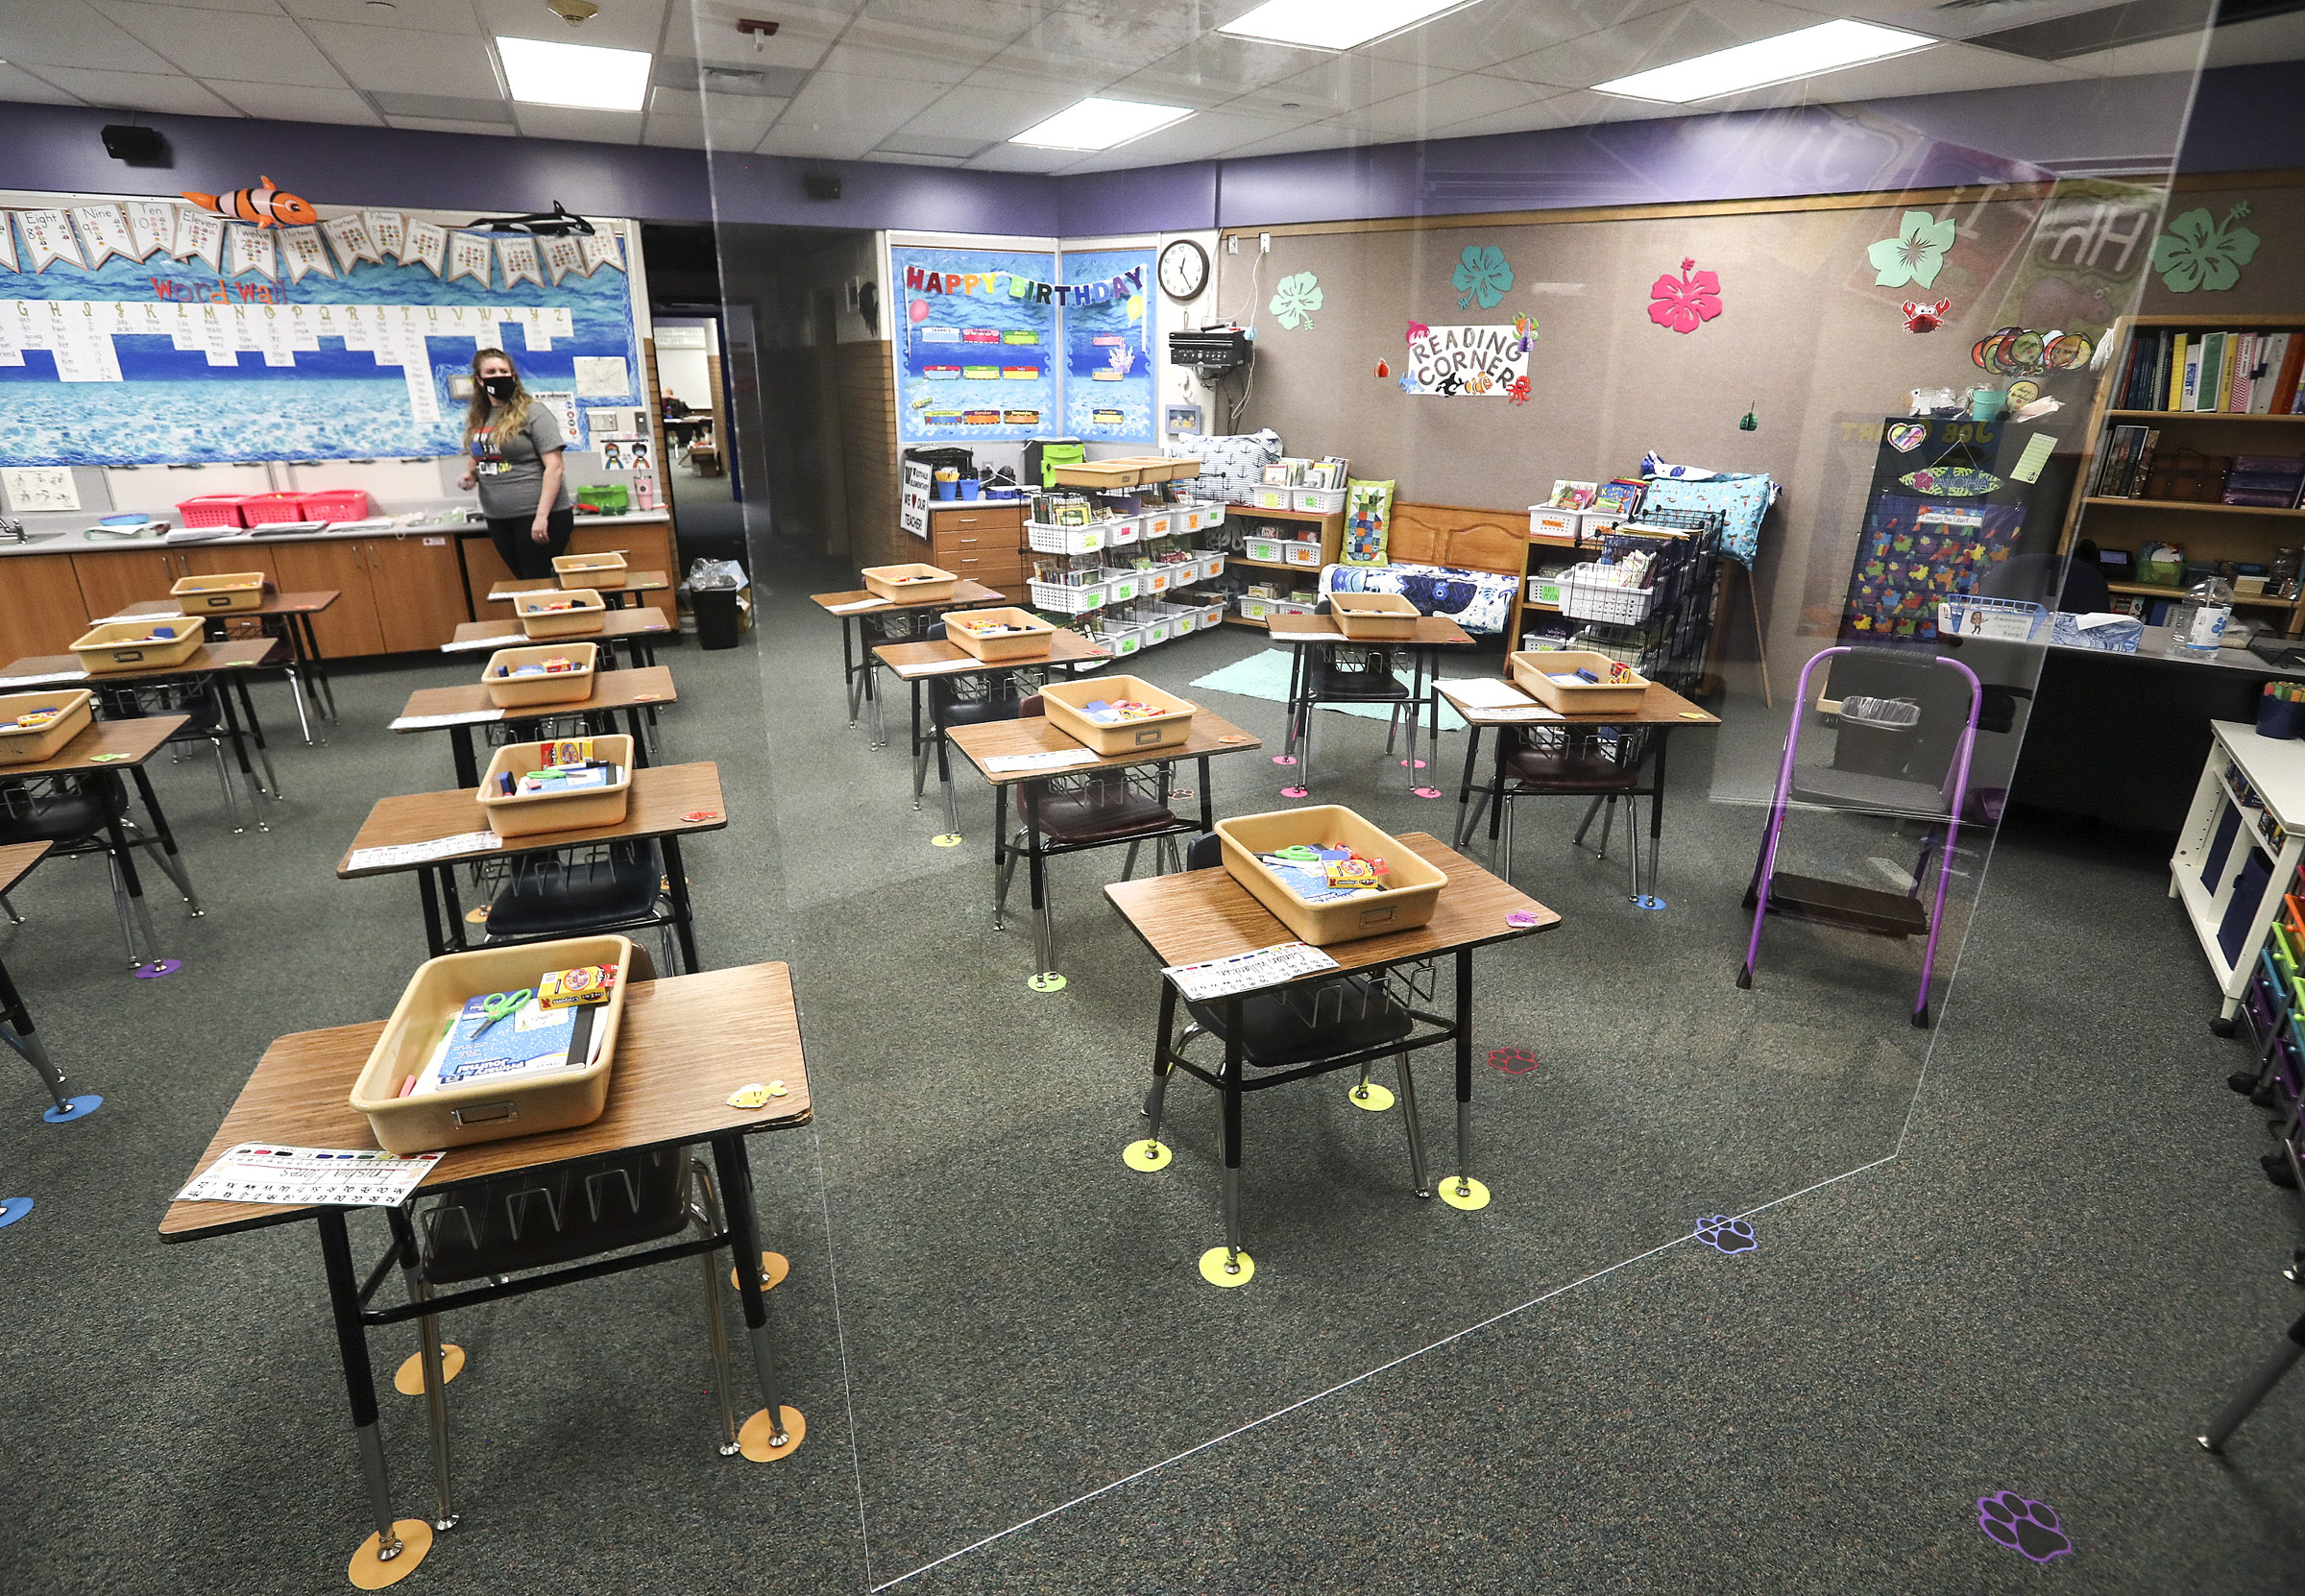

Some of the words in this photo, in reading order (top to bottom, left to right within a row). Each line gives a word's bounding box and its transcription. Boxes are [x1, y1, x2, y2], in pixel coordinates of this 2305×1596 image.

[83, 207, 112, 219] Nine
[138, 203, 163, 216] Ten
[25, 211, 58, 229] Eight
[132, 217, 150, 230] 10
[182, 209, 219, 230] Eleven
[326, 216, 359, 230] Fourteen
[26, 228, 36, 239] 8
[83, 223, 93, 235] 9
[234, 225, 270, 239] Twelve
[281, 229, 314, 239] Thirteen
[906, 265, 998, 295] HAPPY
[1008, 265, 1143, 306] BIRTHDAY
[1412, 326, 1522, 364] READING
[1418, 350, 1515, 389] CORNER
[1933, 474, 1991, 490] ALOHA
[904, 493, 911, 506] WE
[916, 497, 926, 512] OUR
[1993, 615, 2028, 624] Awesome
[2002, 630, 2024, 639] here!
[552, 996, 579, 1005] Crayons
[457, 1058, 510, 1073] Journal
[474, 1060, 524, 1076] Primary
[279, 1168, 329, 1185] Flores
